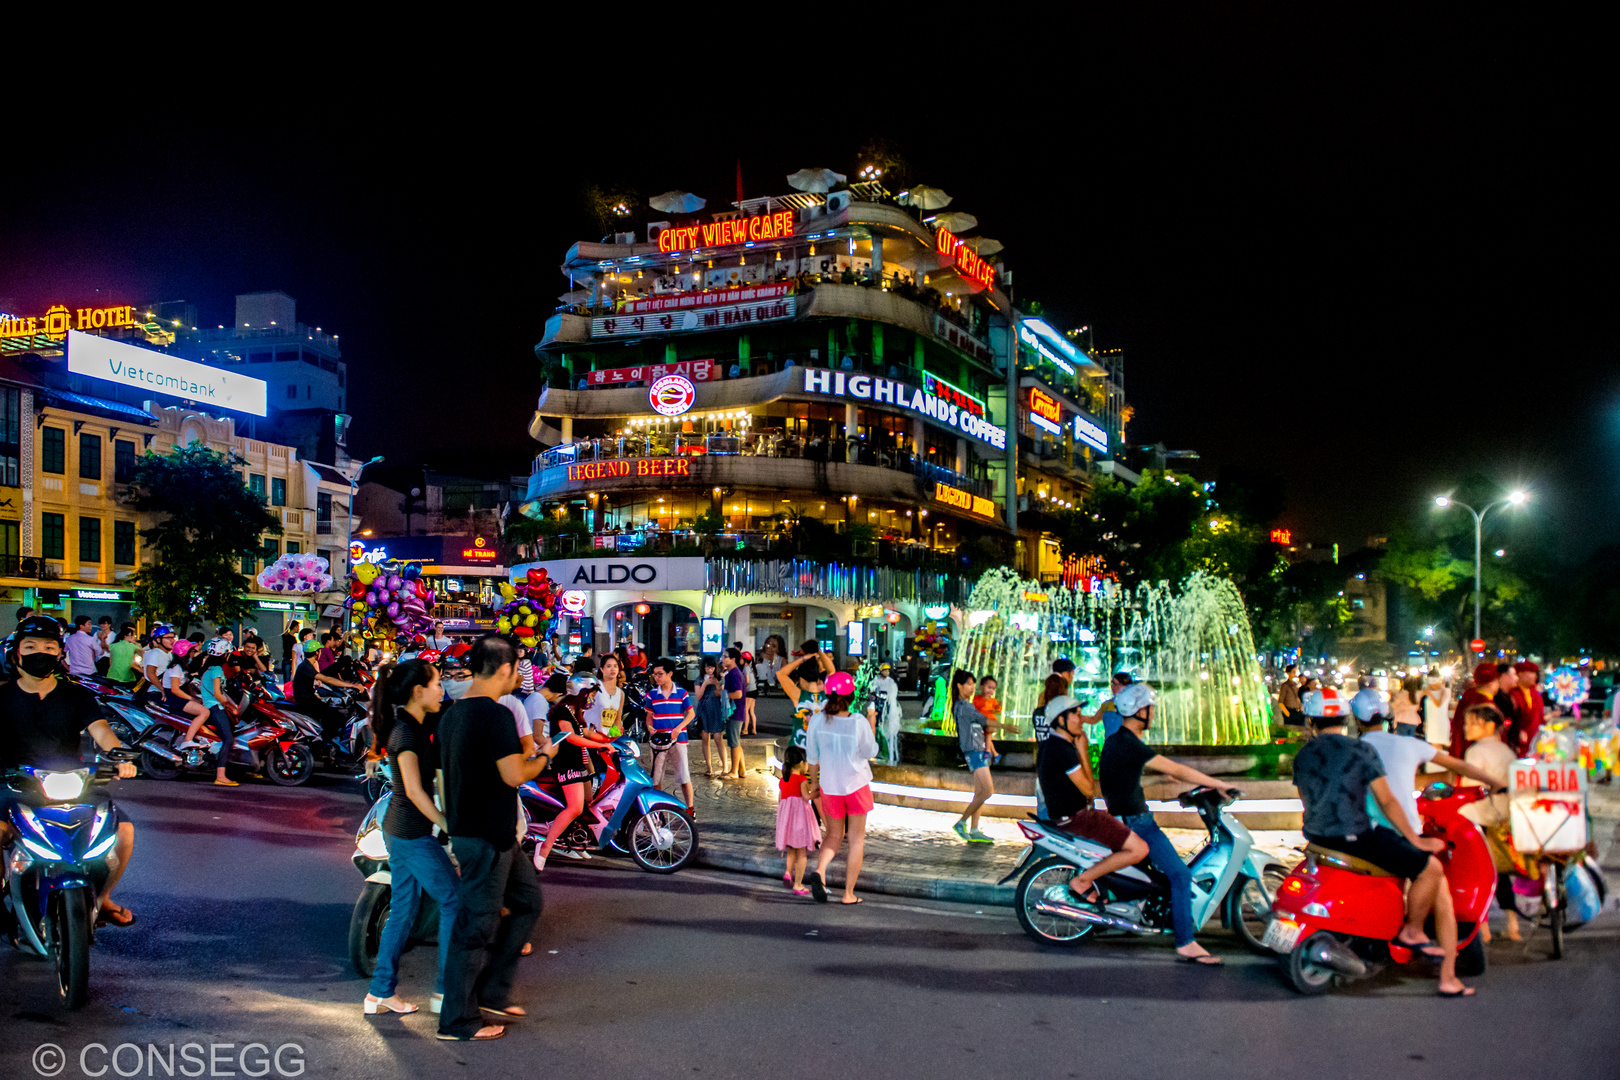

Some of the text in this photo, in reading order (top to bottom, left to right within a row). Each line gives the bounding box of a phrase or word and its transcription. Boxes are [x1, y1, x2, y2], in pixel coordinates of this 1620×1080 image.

[658, 210, 793, 252] CITY VIEW CAFE
[76, 306, 134, 330] HOTEL
[109, 358, 216, 399] Vietcombank
[594, 367, 642, 383] 하노이
[805, 368, 958, 427] HIGHLANDS
[959, 410, 1006, 450] COFFEE
[568, 458, 690, 482] LEGEND BEER
[474, 550, 496, 558] TRANG
[573, 564, 657, 585] ALDO
